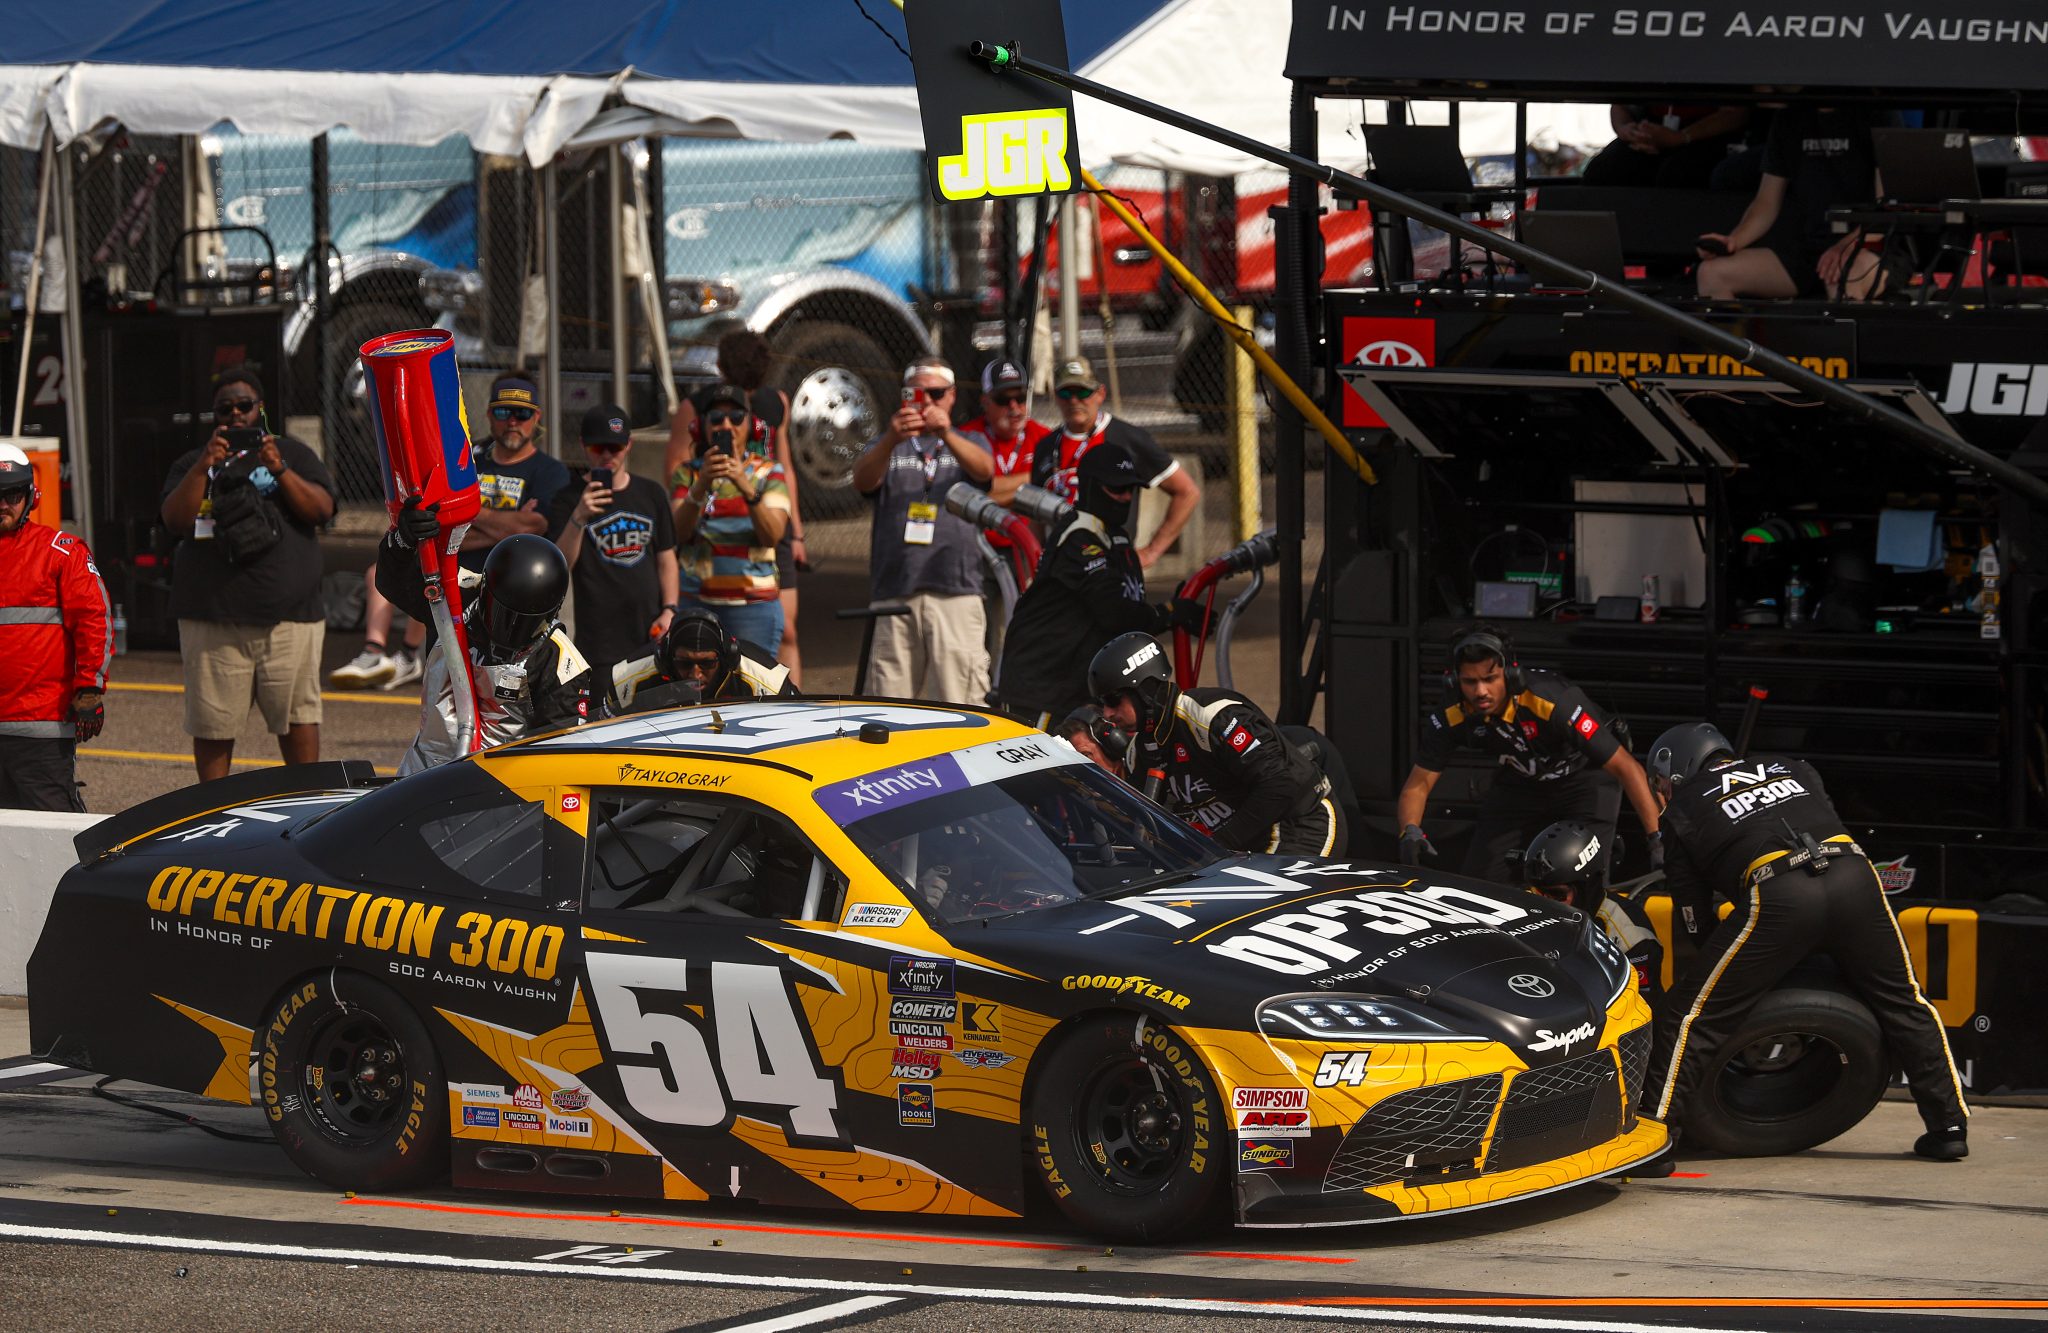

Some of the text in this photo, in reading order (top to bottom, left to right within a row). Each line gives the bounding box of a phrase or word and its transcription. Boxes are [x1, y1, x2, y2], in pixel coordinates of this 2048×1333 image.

[1327, 5, 2048, 44] IN HONOR OF SOC AARON VAUGHN
[940, 110, 1071, 199] JGR
[1928, 362, 2048, 416] JG
[1122, 642, 1160, 676] JGR
[996, 743, 1051, 764] GRAY
[841, 767, 943, 807] xfinity
[1721, 778, 1805, 820] OP300
[1574, 834, 1601, 872] JGR
[852, 915, 896, 924] RACE CAR
[865, 906, 902, 917] NASCAR
[146, 865, 565, 981] OPERATION 300
[1205, 886, 1529, 975] OP300
[151, 917, 273, 950] IN HONOR OF
[914, 961, 937, 970] NASCAR
[1331, 958, 1388, 983] HONOR
[1388, 946, 1409, 959] OF
[1410, 933, 1449, 950] SOC
[389, 961, 557, 1002] SOC AARON VAUGHN
[899, 968, 943, 990] xfinity
[912, 985, 931, 993] SERIES
[892, 1001, 956, 1019] COMETIC
[892, 1022, 942, 1037] LINCOLN
[963, 1033, 1002, 1043] KENNAMETAL
[1527, 1022, 1596, 1056] Supra
[585, 952, 839, 1138] 54
[903, 1037, 948, 1049] WELDERS
[892, 1048, 942, 1070] Holley
[891, 1065, 935, 1079] MSD
[1313, 1051, 1371, 1088] 54
[466, 1089, 500, 1098] SIEMENS
[515, 1085, 541, 1100] MAG
[902, 1095, 931, 1103] SUNOCO
[1236, 1089, 1304, 1108] SIMPSON
[515, 1100, 542, 1108] TOOLS
[902, 1110, 932, 1118] ROOKIE
[395, 1080, 426, 1155] EAGLE
[504, 1112, 537, 1122] LINCOLN
[511, 1121, 540, 1130] WELDERS
[549, 1118, 577, 1132] Mobil
[1240, 1111, 1308, 1126] ARP
[1034, 1124, 1072, 1199] EAGLE
[1243, 1149, 1289, 1161] SUNOCO
